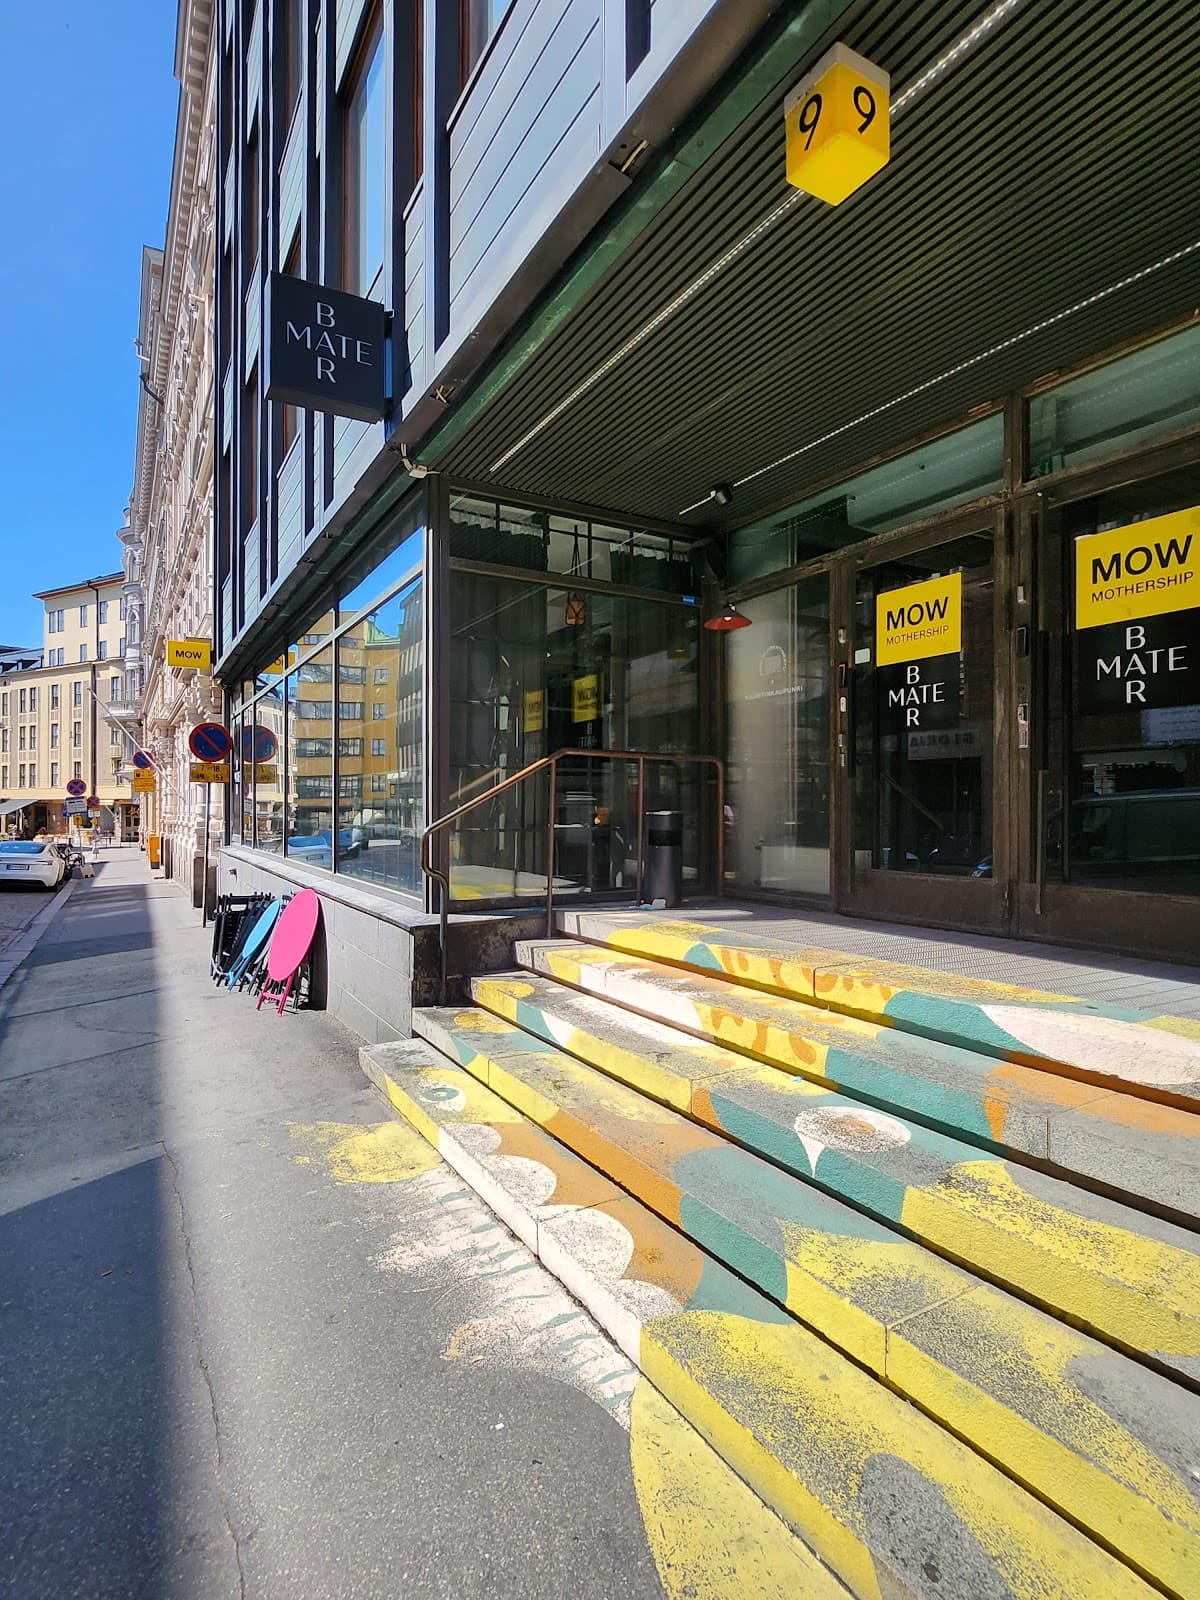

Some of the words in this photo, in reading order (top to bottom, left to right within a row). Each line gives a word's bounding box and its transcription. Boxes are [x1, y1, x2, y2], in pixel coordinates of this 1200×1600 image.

[799, 93, 823, 151] 9
[853, 85, 877, 134] 9
[286, 320, 373, 366] MATE
[1091, 534, 1193, 585] MOW
[1091, 571, 1194, 603] MOTHERSHIP
[886, 596, 949, 631] MOW
[886, 624, 949, 646] MOTHERSHIP
[175, 649, 202, 660] MOW
[1096, 645, 1188, 681] MATE
[888, 682, 945, 708] MATE
